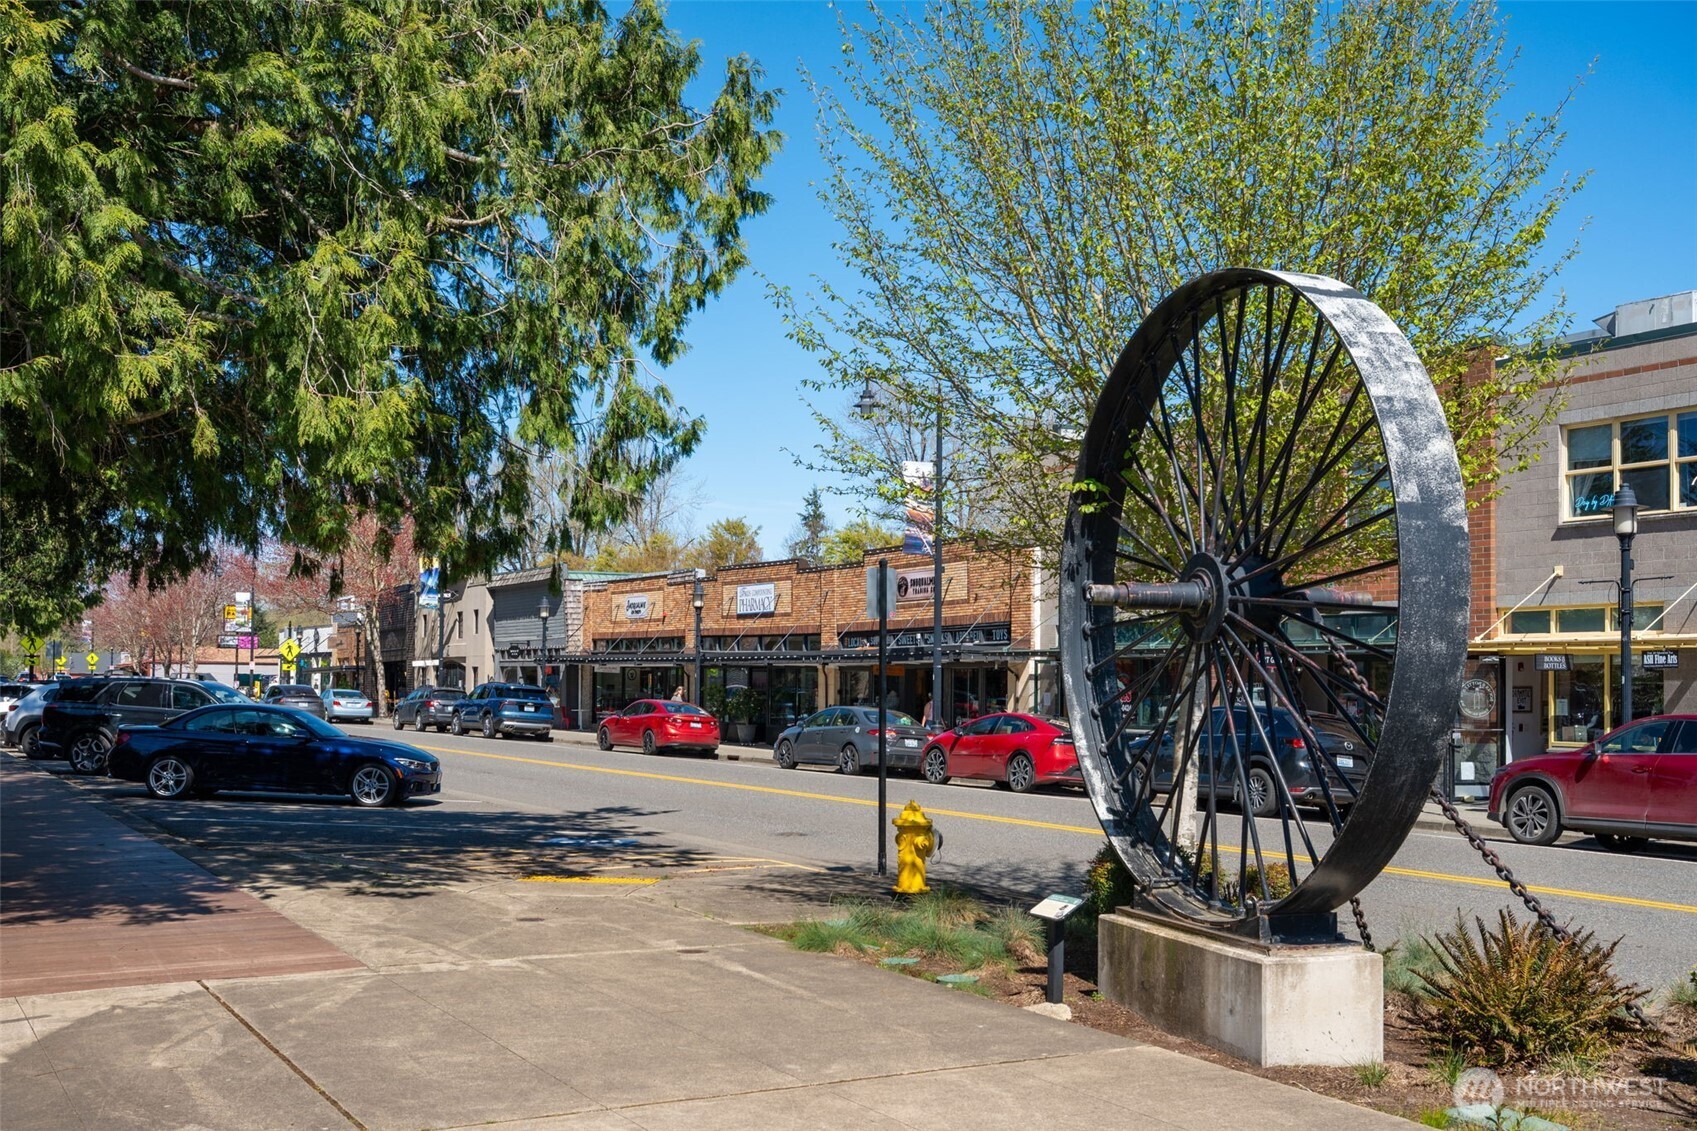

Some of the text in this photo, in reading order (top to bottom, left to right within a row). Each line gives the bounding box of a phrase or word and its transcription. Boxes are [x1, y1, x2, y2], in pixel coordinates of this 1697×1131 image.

[739, 596, 773, 612] PHARMACY
[992, 628, 1008, 640] TOYS
[1544, 655, 1562, 663] BOOKS
[1655, 654, 1667, 665] Fine
[1667, 653, 1678, 664] Arts
[1544, 662, 1567, 670] BOTTLES
